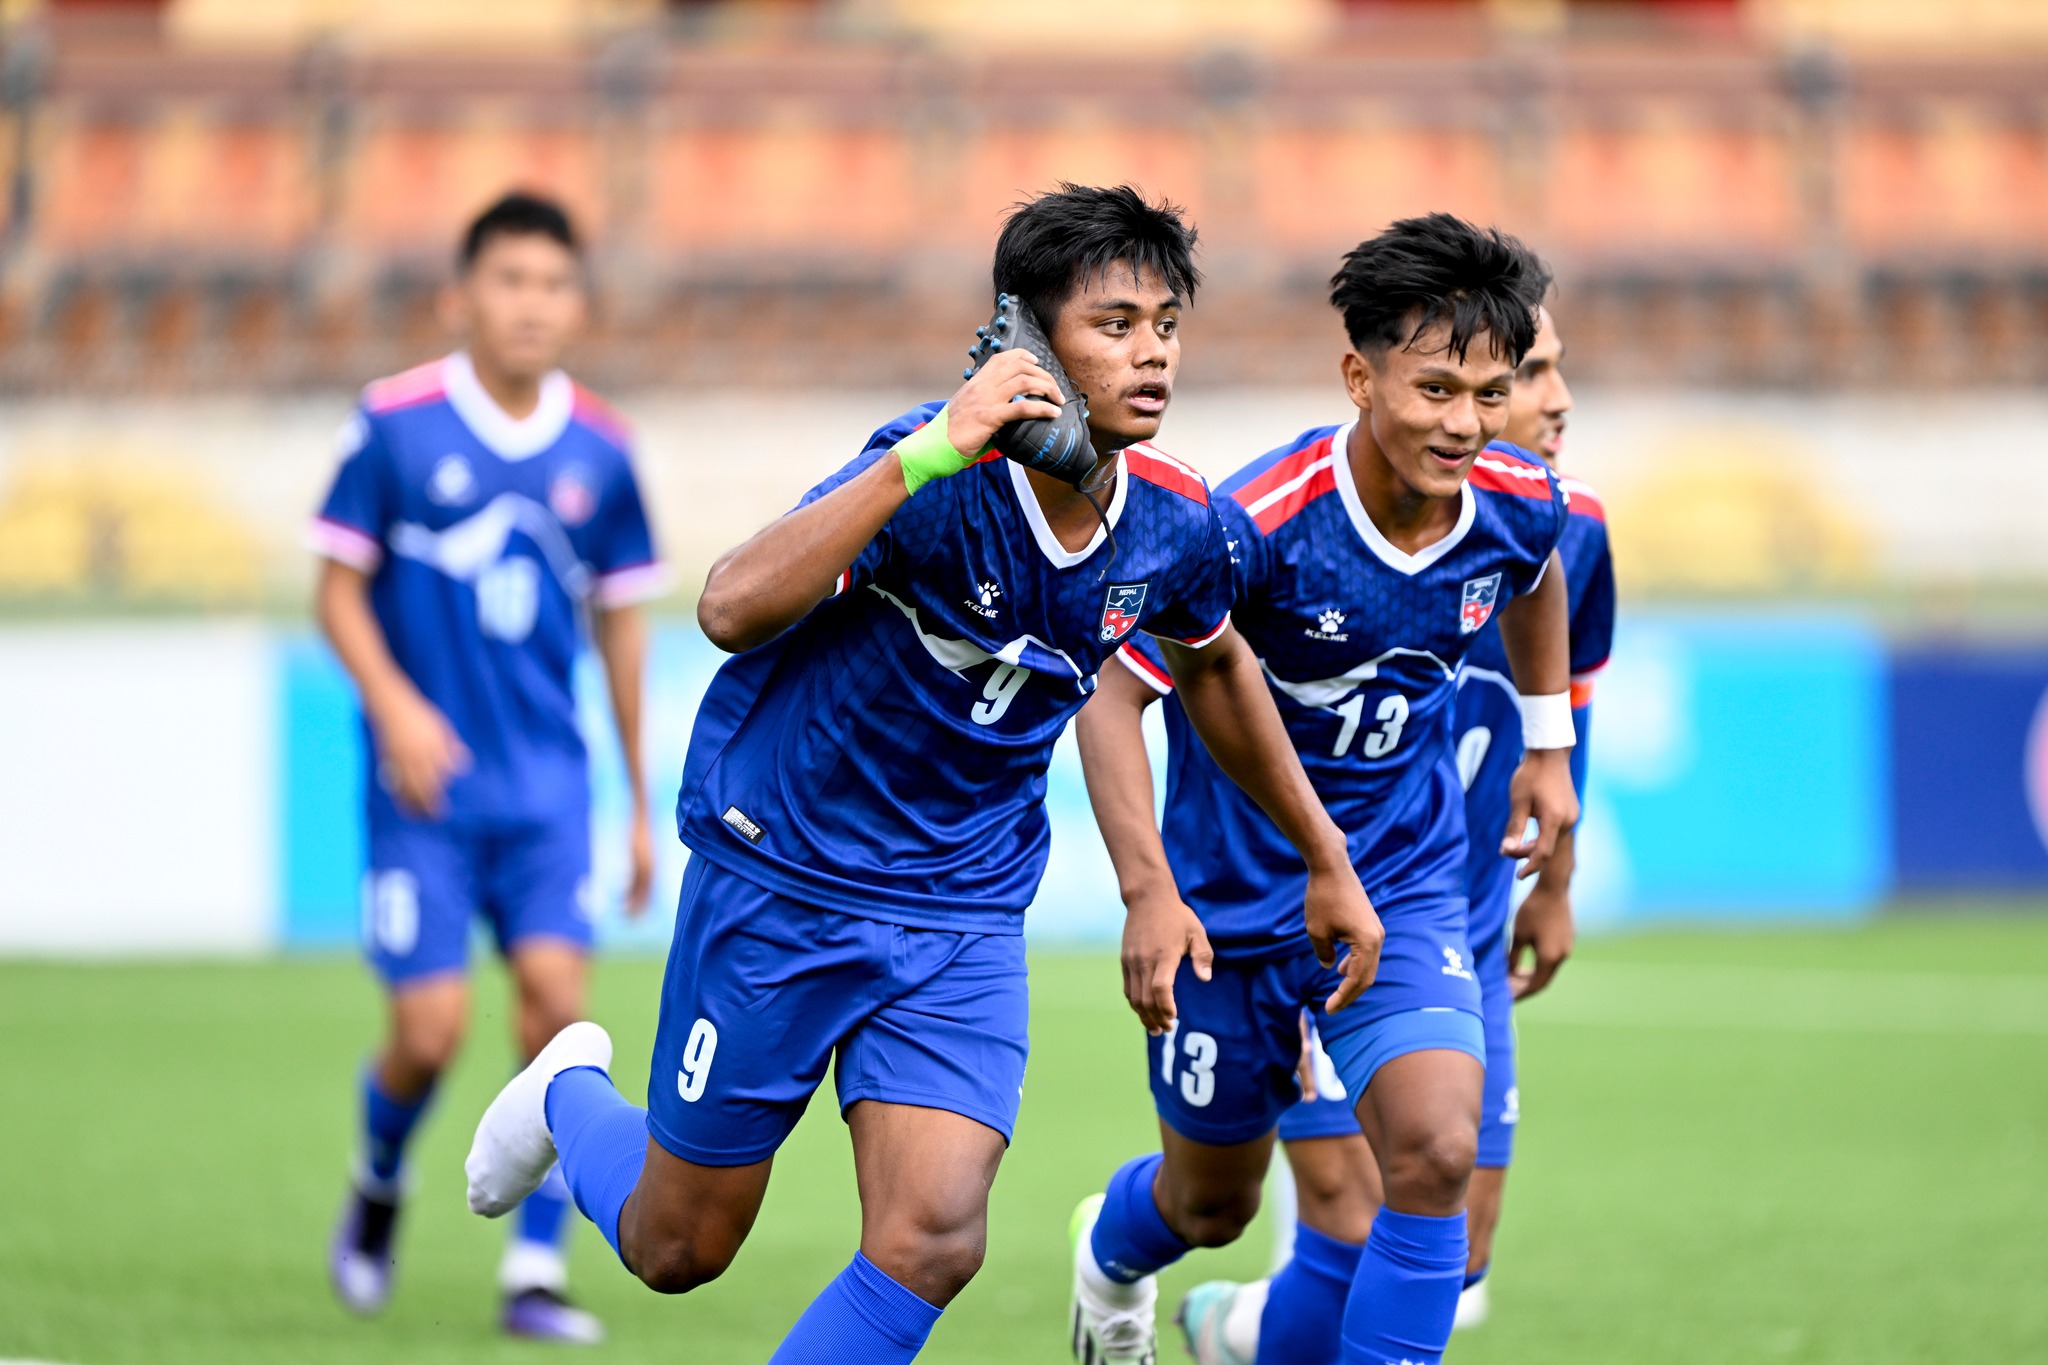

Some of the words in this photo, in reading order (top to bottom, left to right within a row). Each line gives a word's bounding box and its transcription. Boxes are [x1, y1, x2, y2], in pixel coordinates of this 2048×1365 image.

[964, 599, 998, 619] KELME
[1118, 588, 1138, 597] NEPAL
[1304, 628, 1349, 643] KELME
[970, 663, 1032, 726] 9
[1332, 693, 1410, 759] 13
[677, 1018, 718, 1103] 9
[1161, 1018, 1218, 1107] 13
